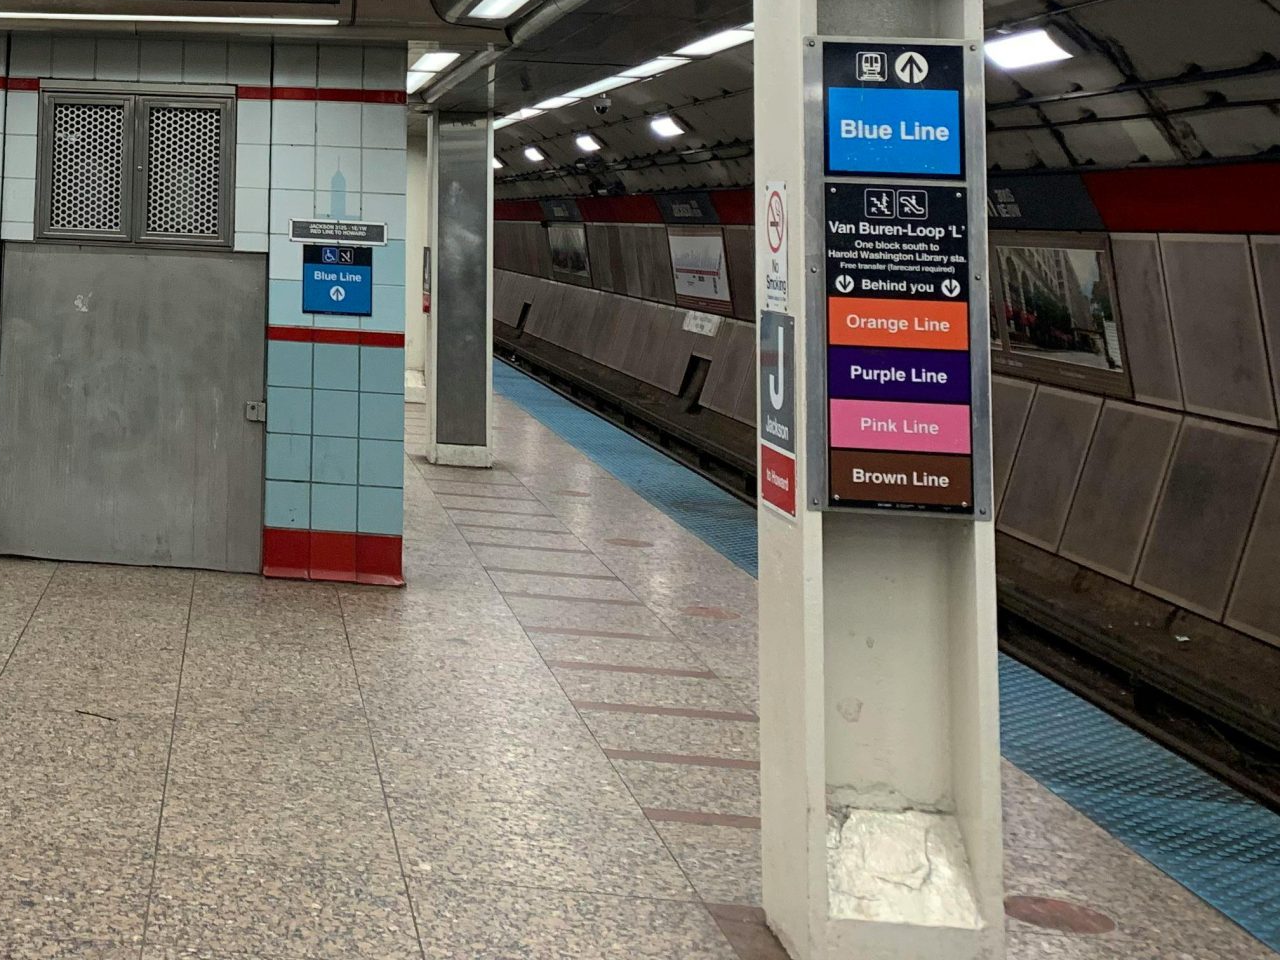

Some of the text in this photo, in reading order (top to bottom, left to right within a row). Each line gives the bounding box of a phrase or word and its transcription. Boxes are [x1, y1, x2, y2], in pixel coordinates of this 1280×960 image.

[840, 119, 949, 141] Blue Line
[829, 221, 855, 234] Van
[859, 222, 945, 240] Buren-Loop
[855, 240, 873, 248] One
[875, 241, 900, 250] block
[902, 242, 927, 250] south
[828, 250, 858, 258] Harold
[860, 251, 913, 262] Washington
[916, 253, 948, 263] Library
[772, 259, 779, 273] No
[922, 265, 955, 274] required)
[314, 271, 361, 282] Blue Line
[767, 274, 786, 294] Smoking
[862, 279, 934, 294] Behind you
[846, 315, 950, 333] Orange Line
[769, 326, 783, 410] J
[850, 365, 947, 383] Purple Line
[766, 414, 788, 440] Jackson
[861, 418, 939, 435] Pink Line
[852, 469, 949, 487] Brown Line
